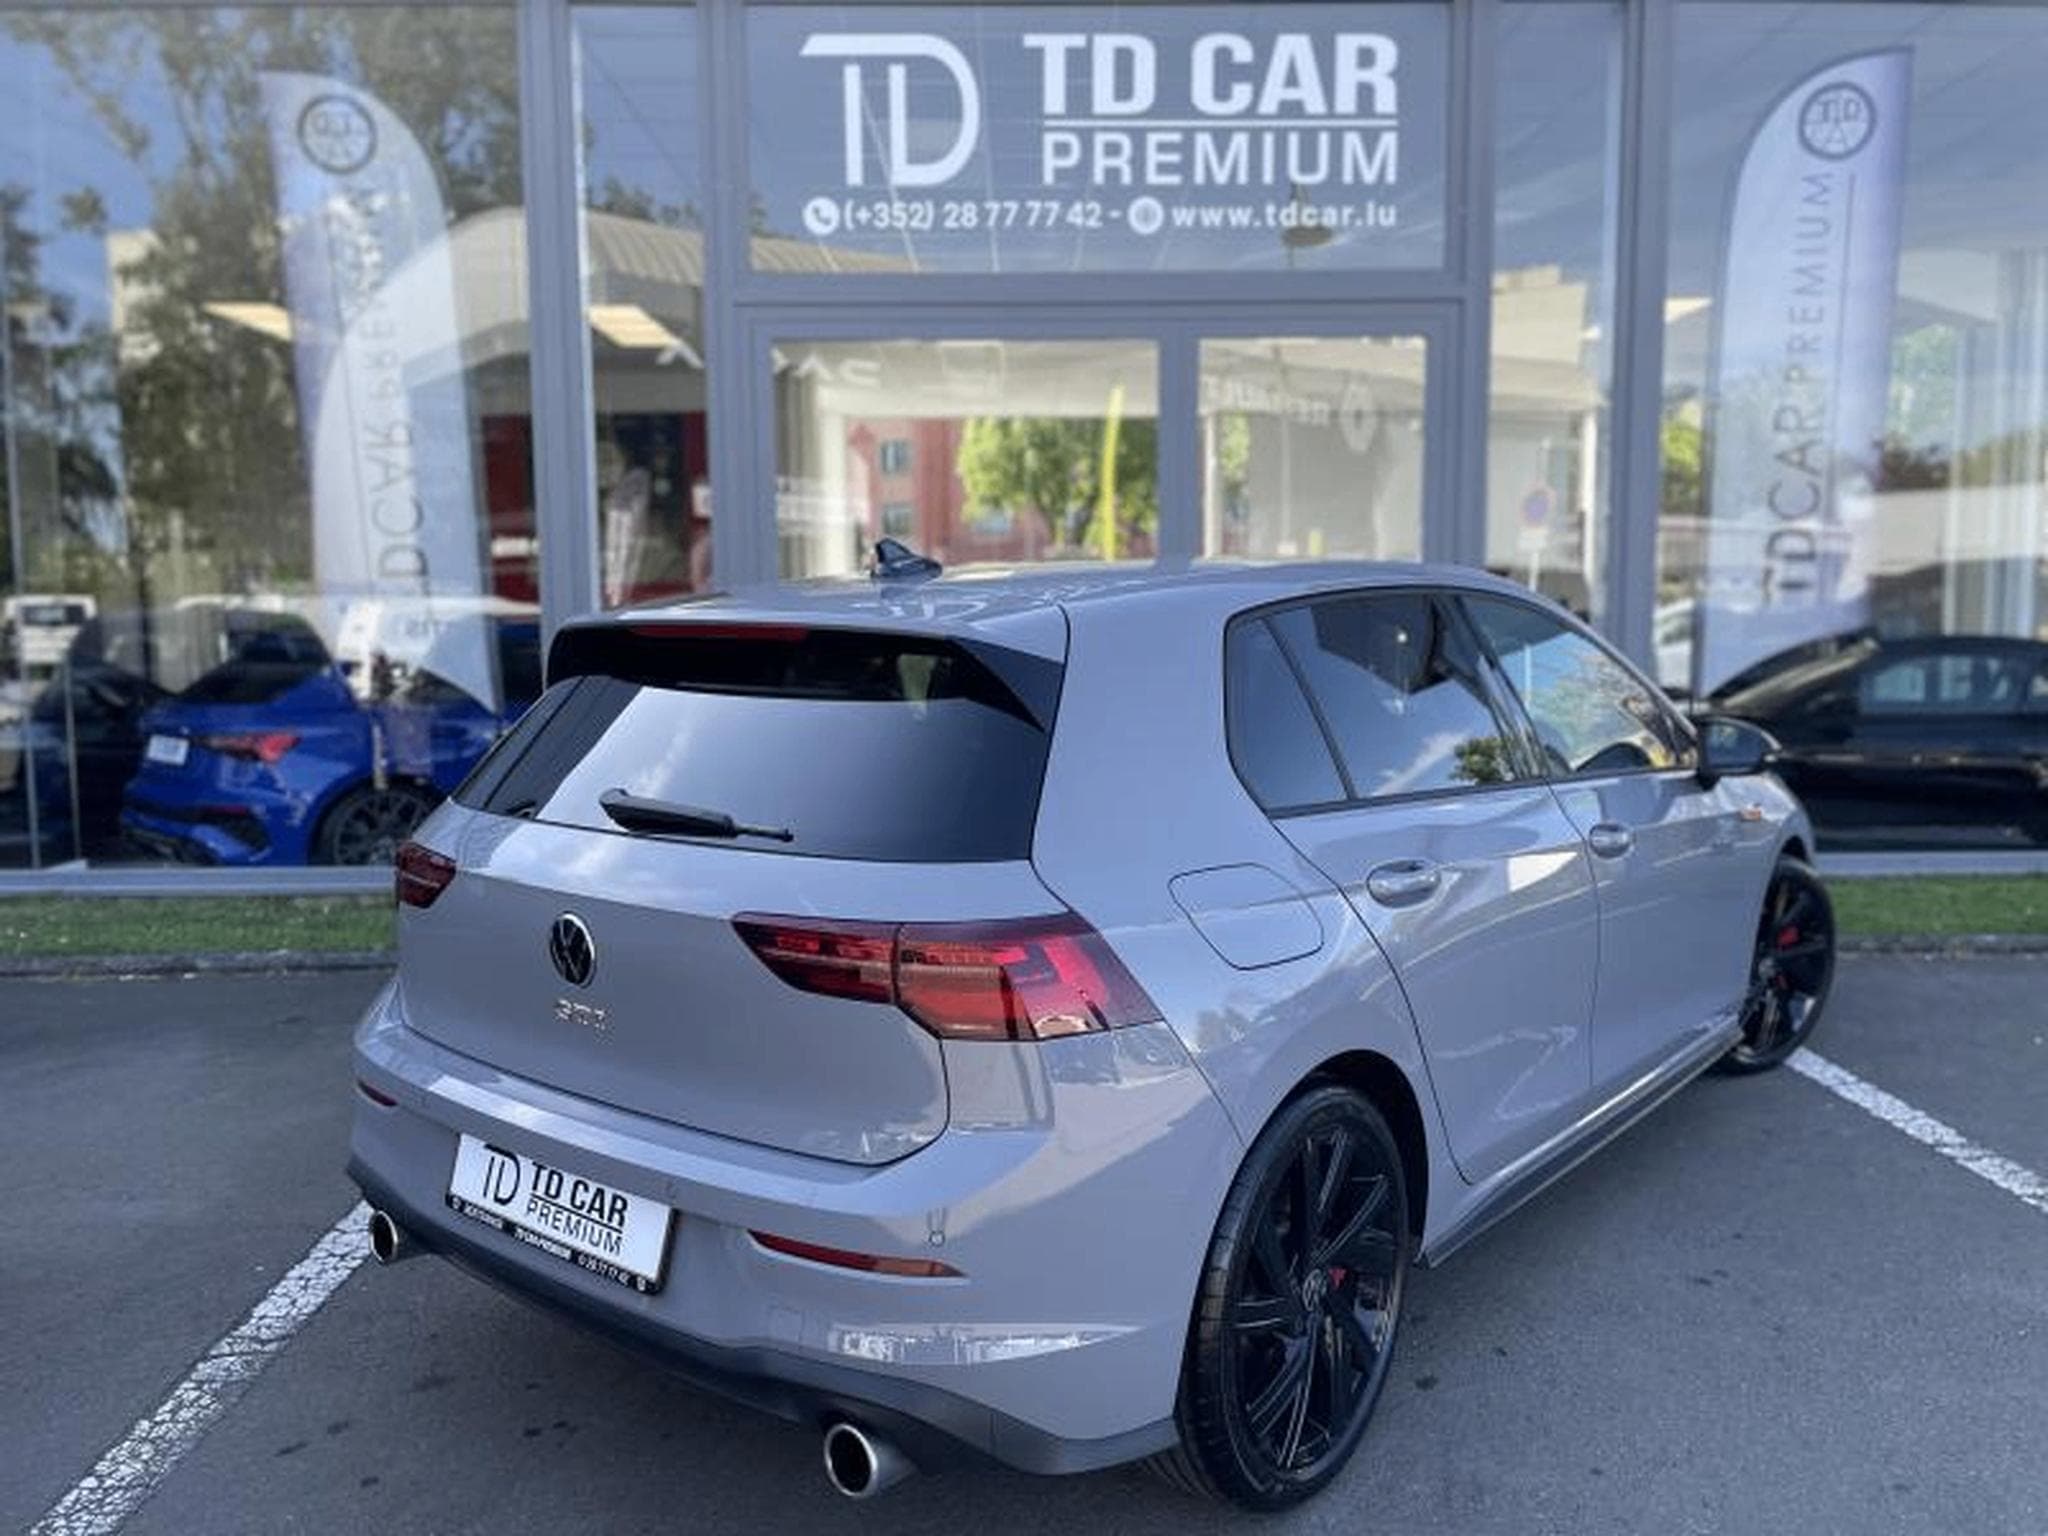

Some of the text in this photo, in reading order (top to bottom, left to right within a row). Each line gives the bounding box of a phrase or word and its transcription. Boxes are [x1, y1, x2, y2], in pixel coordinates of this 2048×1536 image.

[1022, 33, 1398, 116] TD CAR
[1042, 131, 1398, 185] PREMIUM
[844, 199, 934, 230] (+352)
[943, 201, 978, 229] 28
[985, 201, 1020, 228] 77
[1027, 201, 1061, 227] 77
[1066, 201, 1103, 229] 42
[1171, 201, 1397, 228] www.tdcar.lu
[1784, 172, 1834, 382] PREMIUM
[530, 1161, 629, 1228] TD CAR
[525, 1198, 622, 1256] PREMIUM
